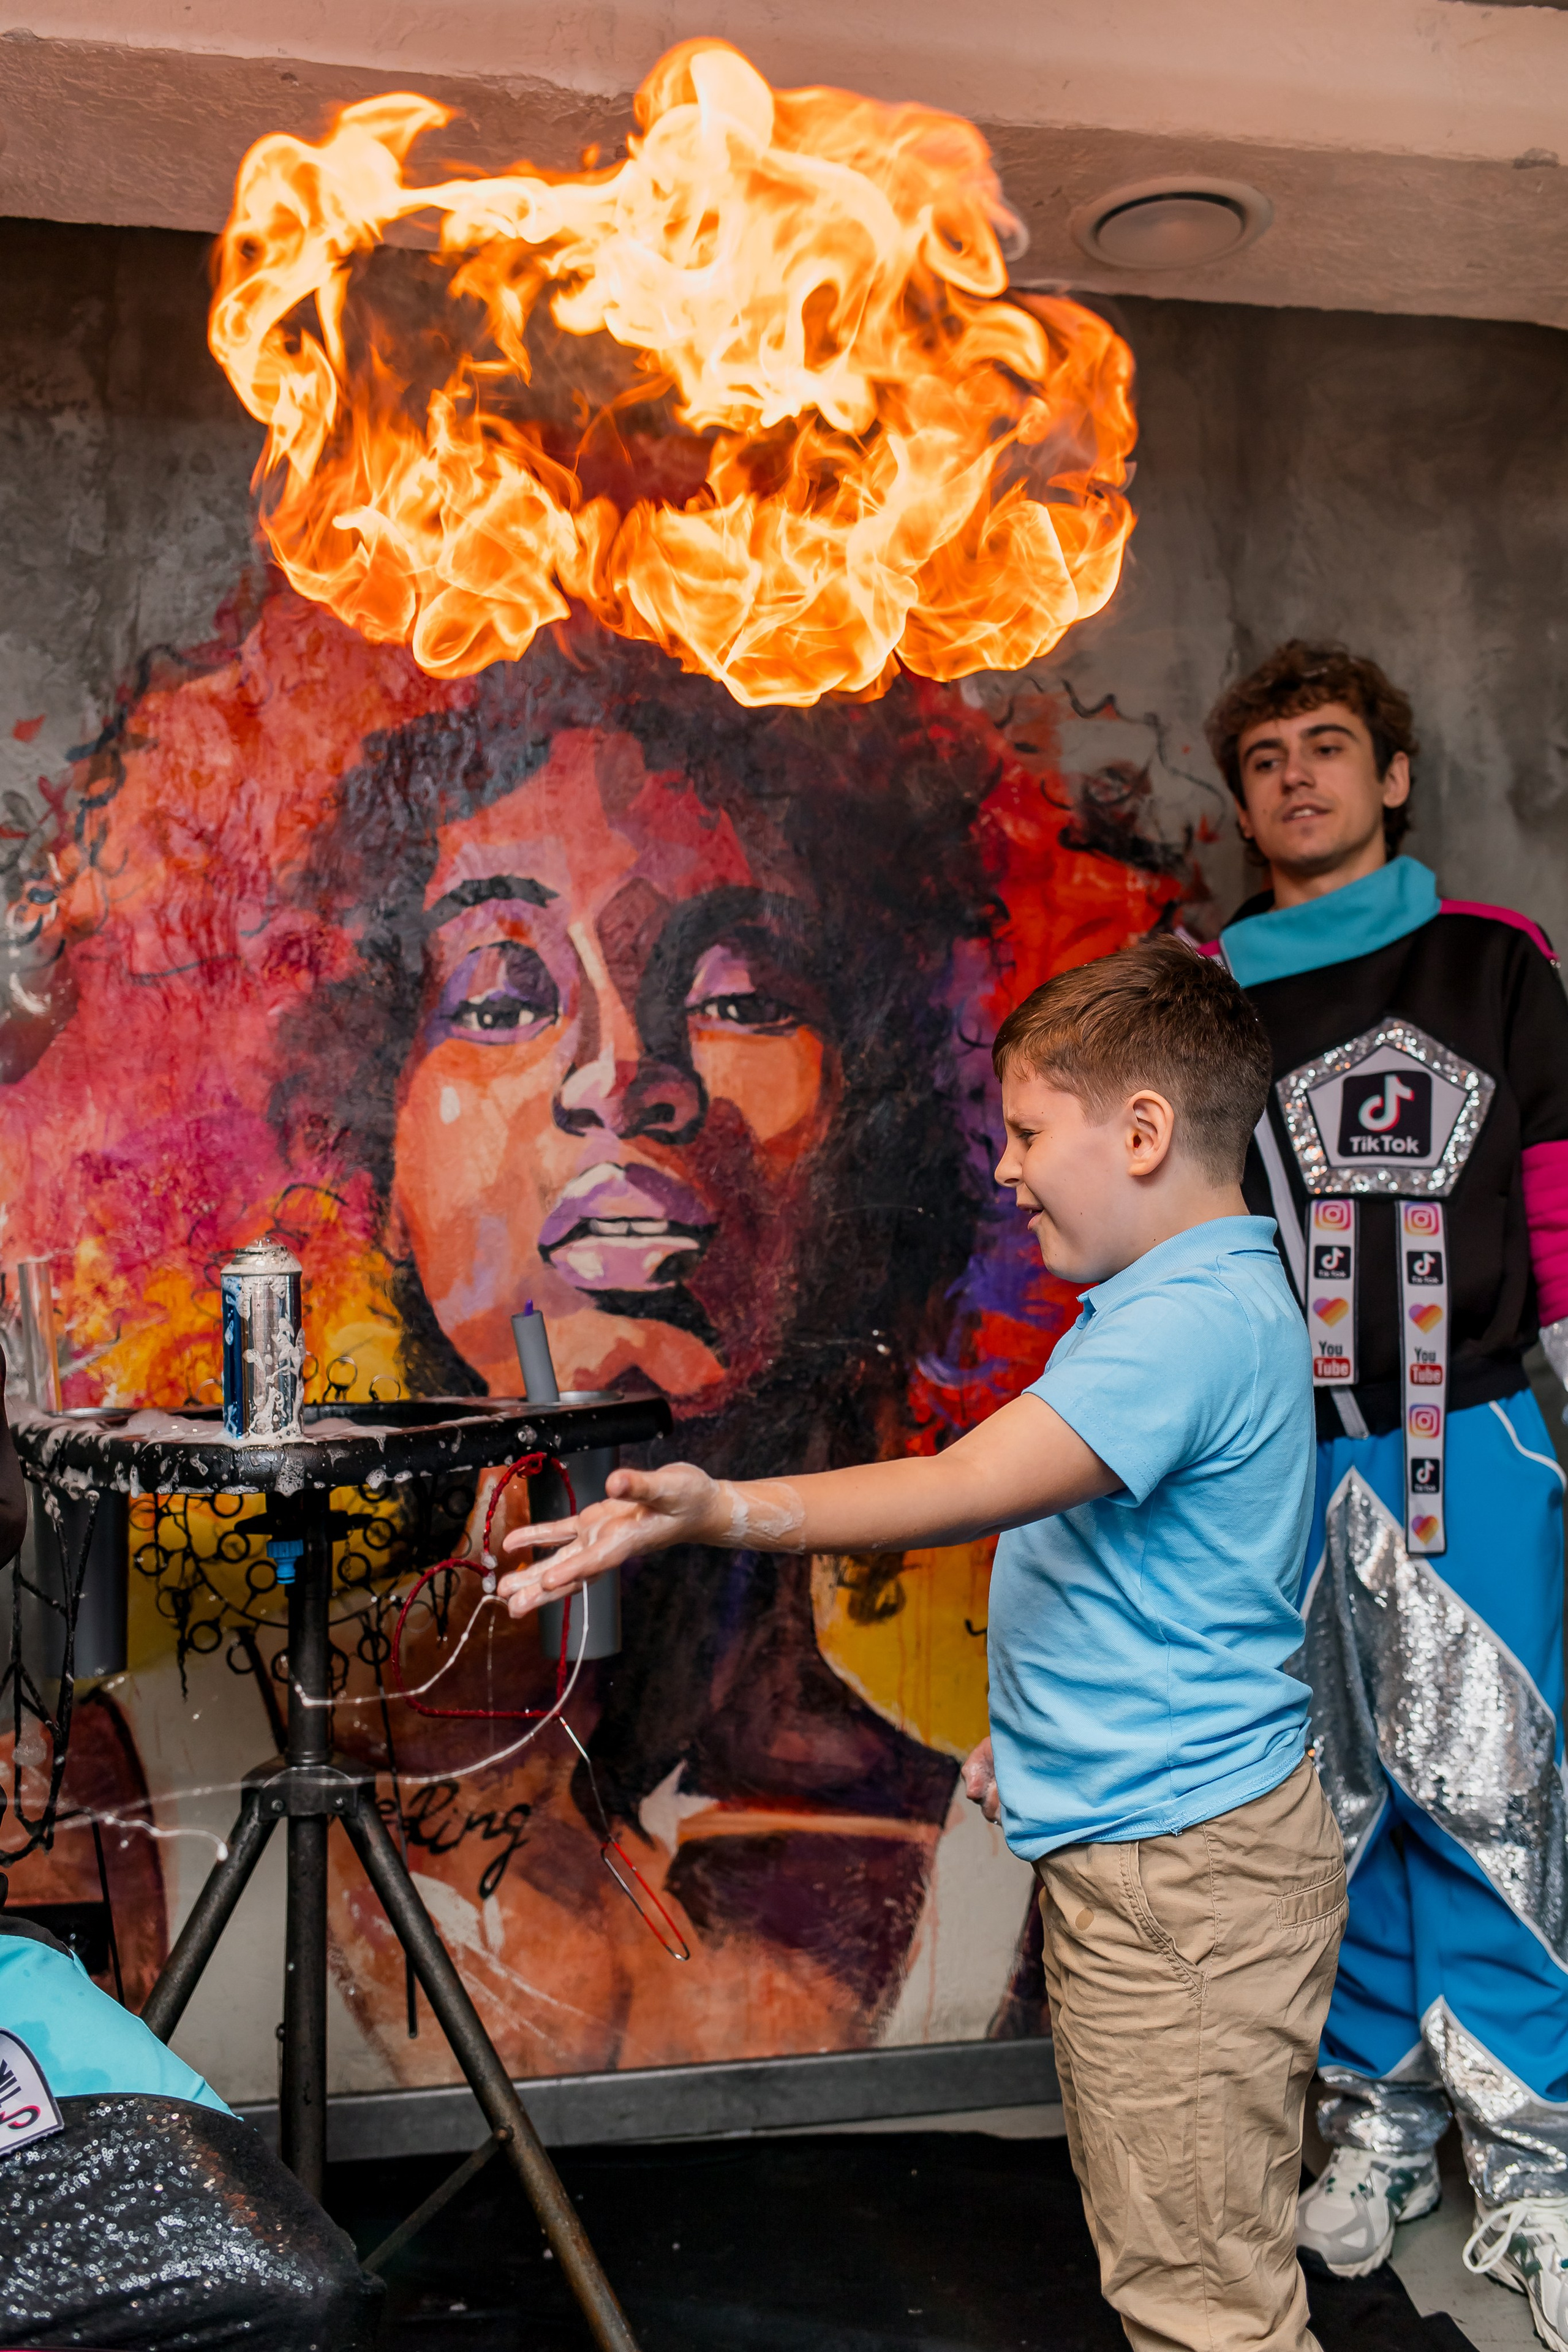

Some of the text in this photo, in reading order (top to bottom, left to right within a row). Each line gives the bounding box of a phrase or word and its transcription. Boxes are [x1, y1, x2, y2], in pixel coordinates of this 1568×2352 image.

[1349, 1135, 1420, 1154] TikTok
[1319, 1340, 1343, 1356] You
[1414, 1346, 1437, 1363] You
[1316, 1359, 1349, 1377] Tube
[1411, 1366, 1441, 1383] Tube
